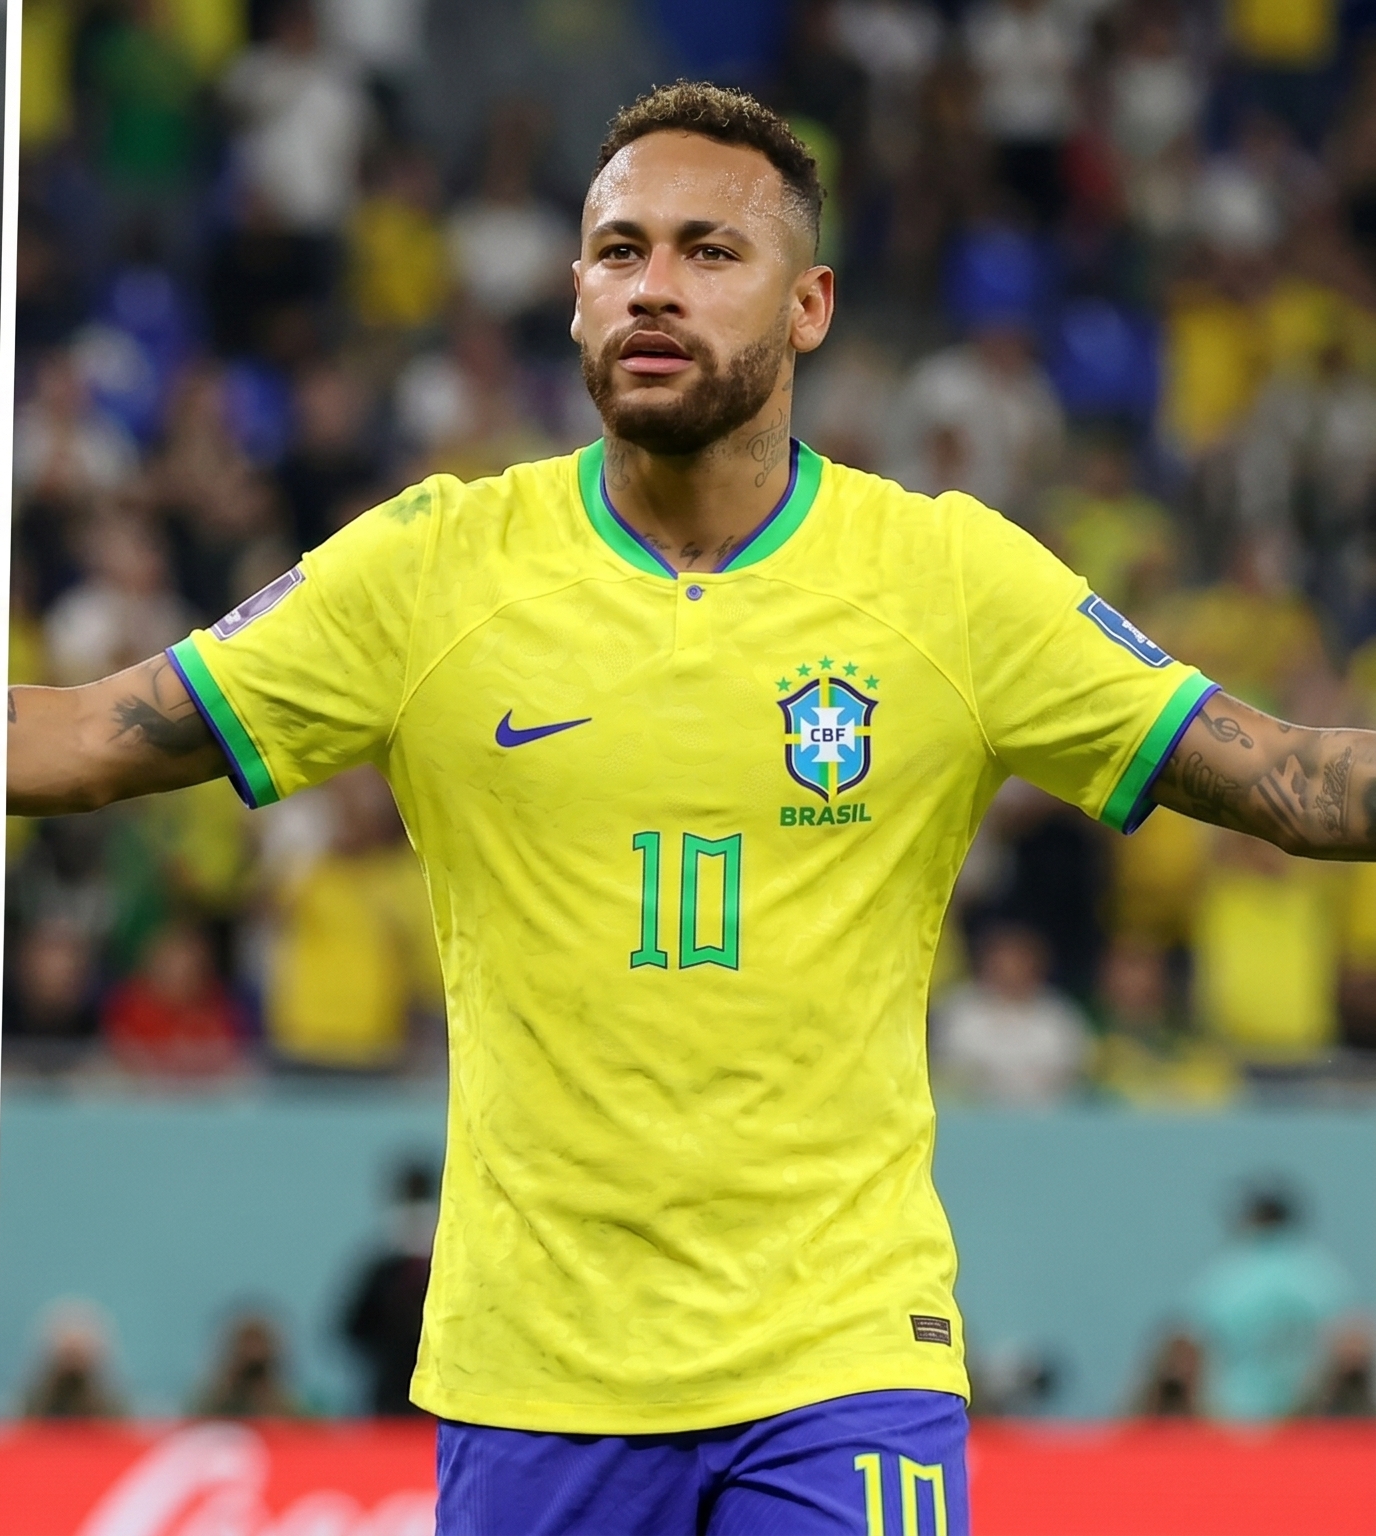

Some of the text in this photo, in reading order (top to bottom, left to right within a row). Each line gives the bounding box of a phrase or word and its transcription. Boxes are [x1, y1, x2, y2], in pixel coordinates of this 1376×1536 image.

[810, 727, 846, 743] CBF
[780, 803, 872, 826] BRASIL
[630, 831, 742, 971] 10
[853, 1451, 948, 1536] 10
